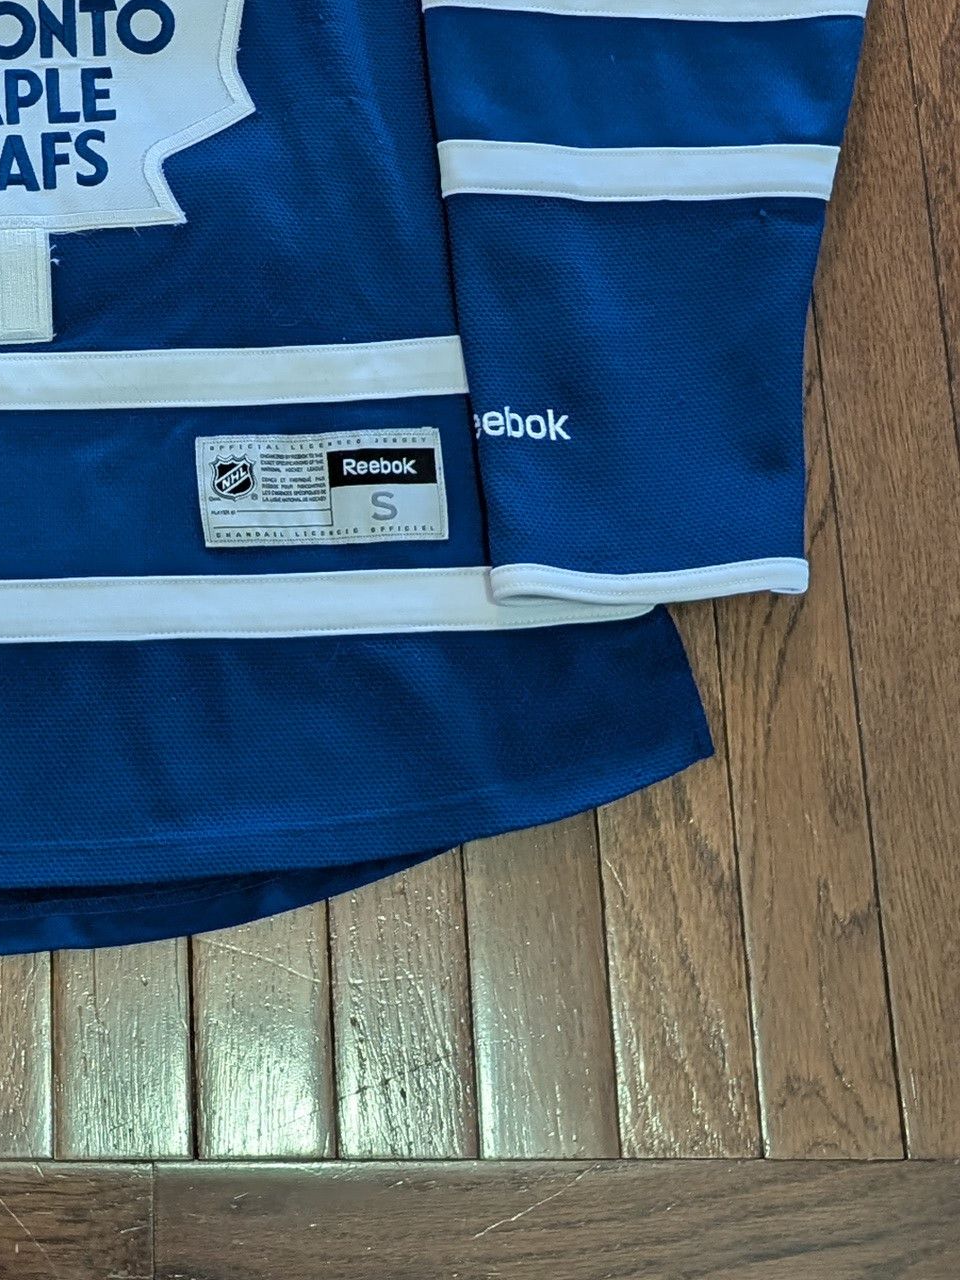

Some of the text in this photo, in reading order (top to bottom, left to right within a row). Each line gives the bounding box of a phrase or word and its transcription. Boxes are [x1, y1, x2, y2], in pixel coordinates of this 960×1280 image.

[221, 466, 247, 490] NHL
[343, 457, 418, 476] Reebok
[371, 490, 398, 521] S
